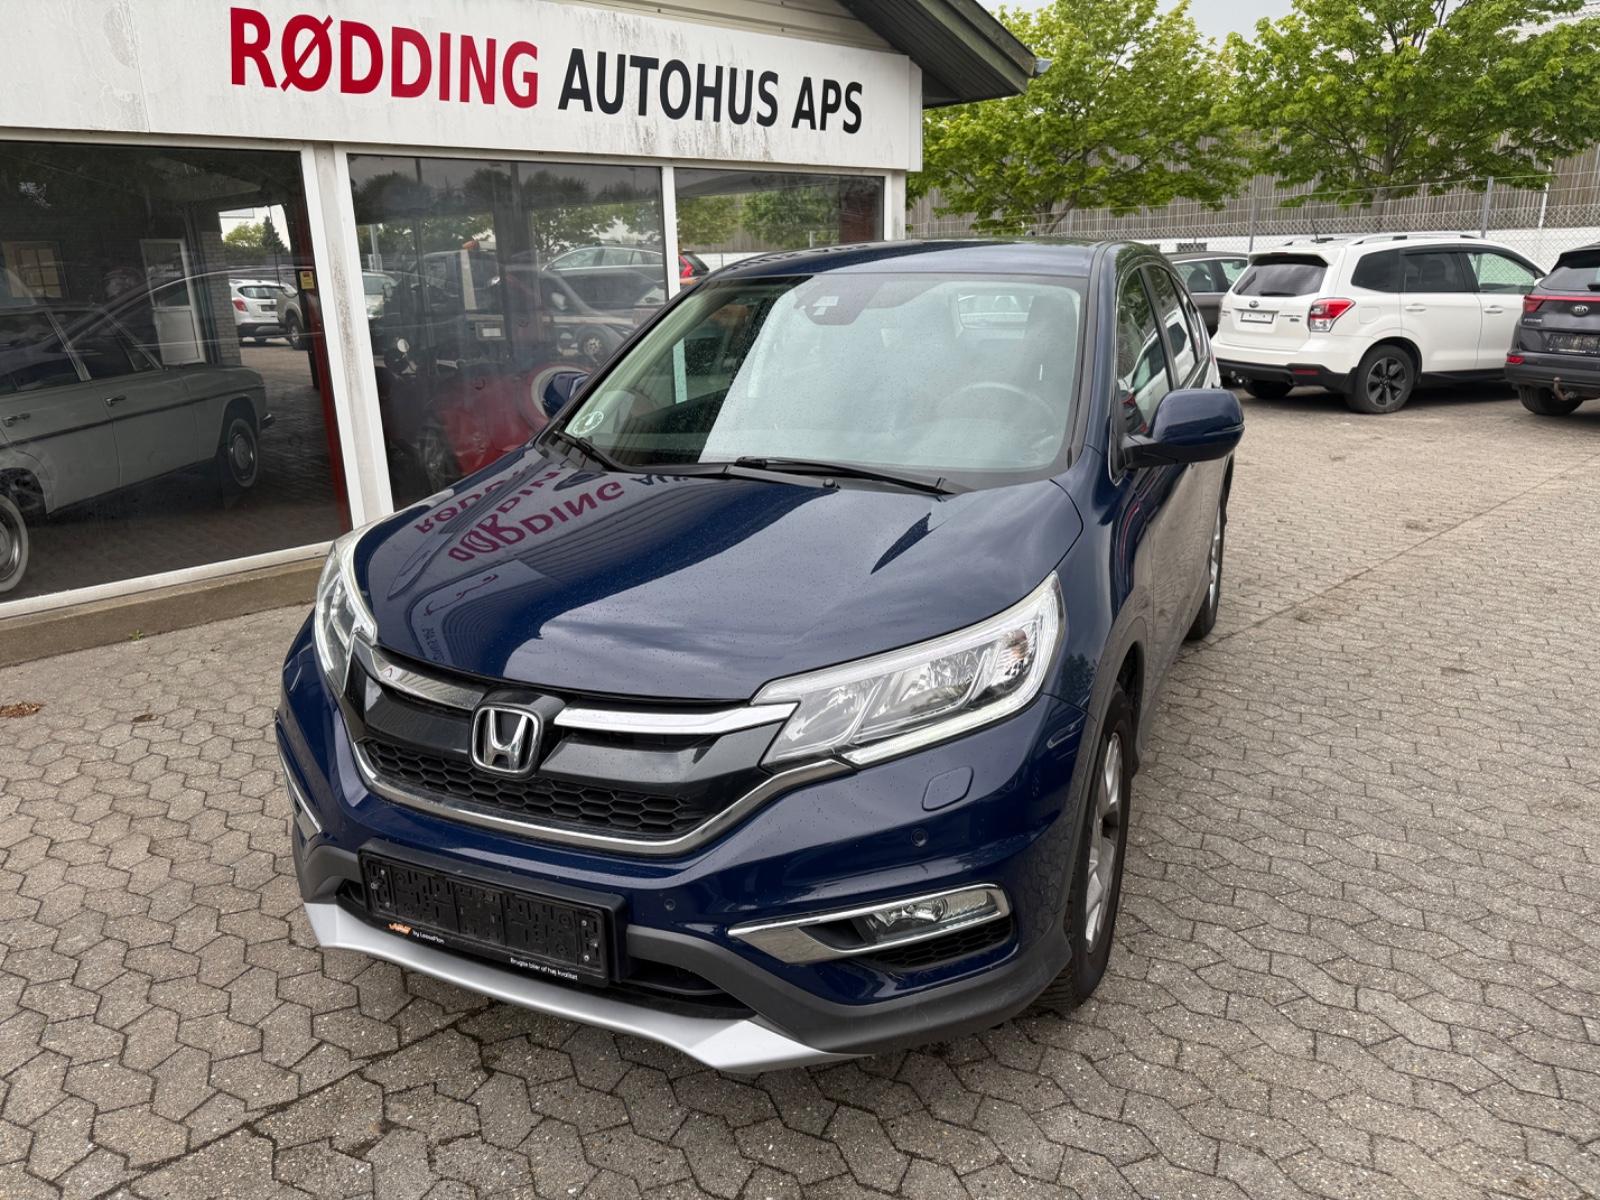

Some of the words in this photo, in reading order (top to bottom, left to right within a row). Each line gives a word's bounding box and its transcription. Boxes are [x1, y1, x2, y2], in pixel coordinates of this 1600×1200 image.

[230, 7, 538, 108] RØDDING
[557, 48, 778, 127] AUTOHUS
[791, 76, 863, 134] APS
